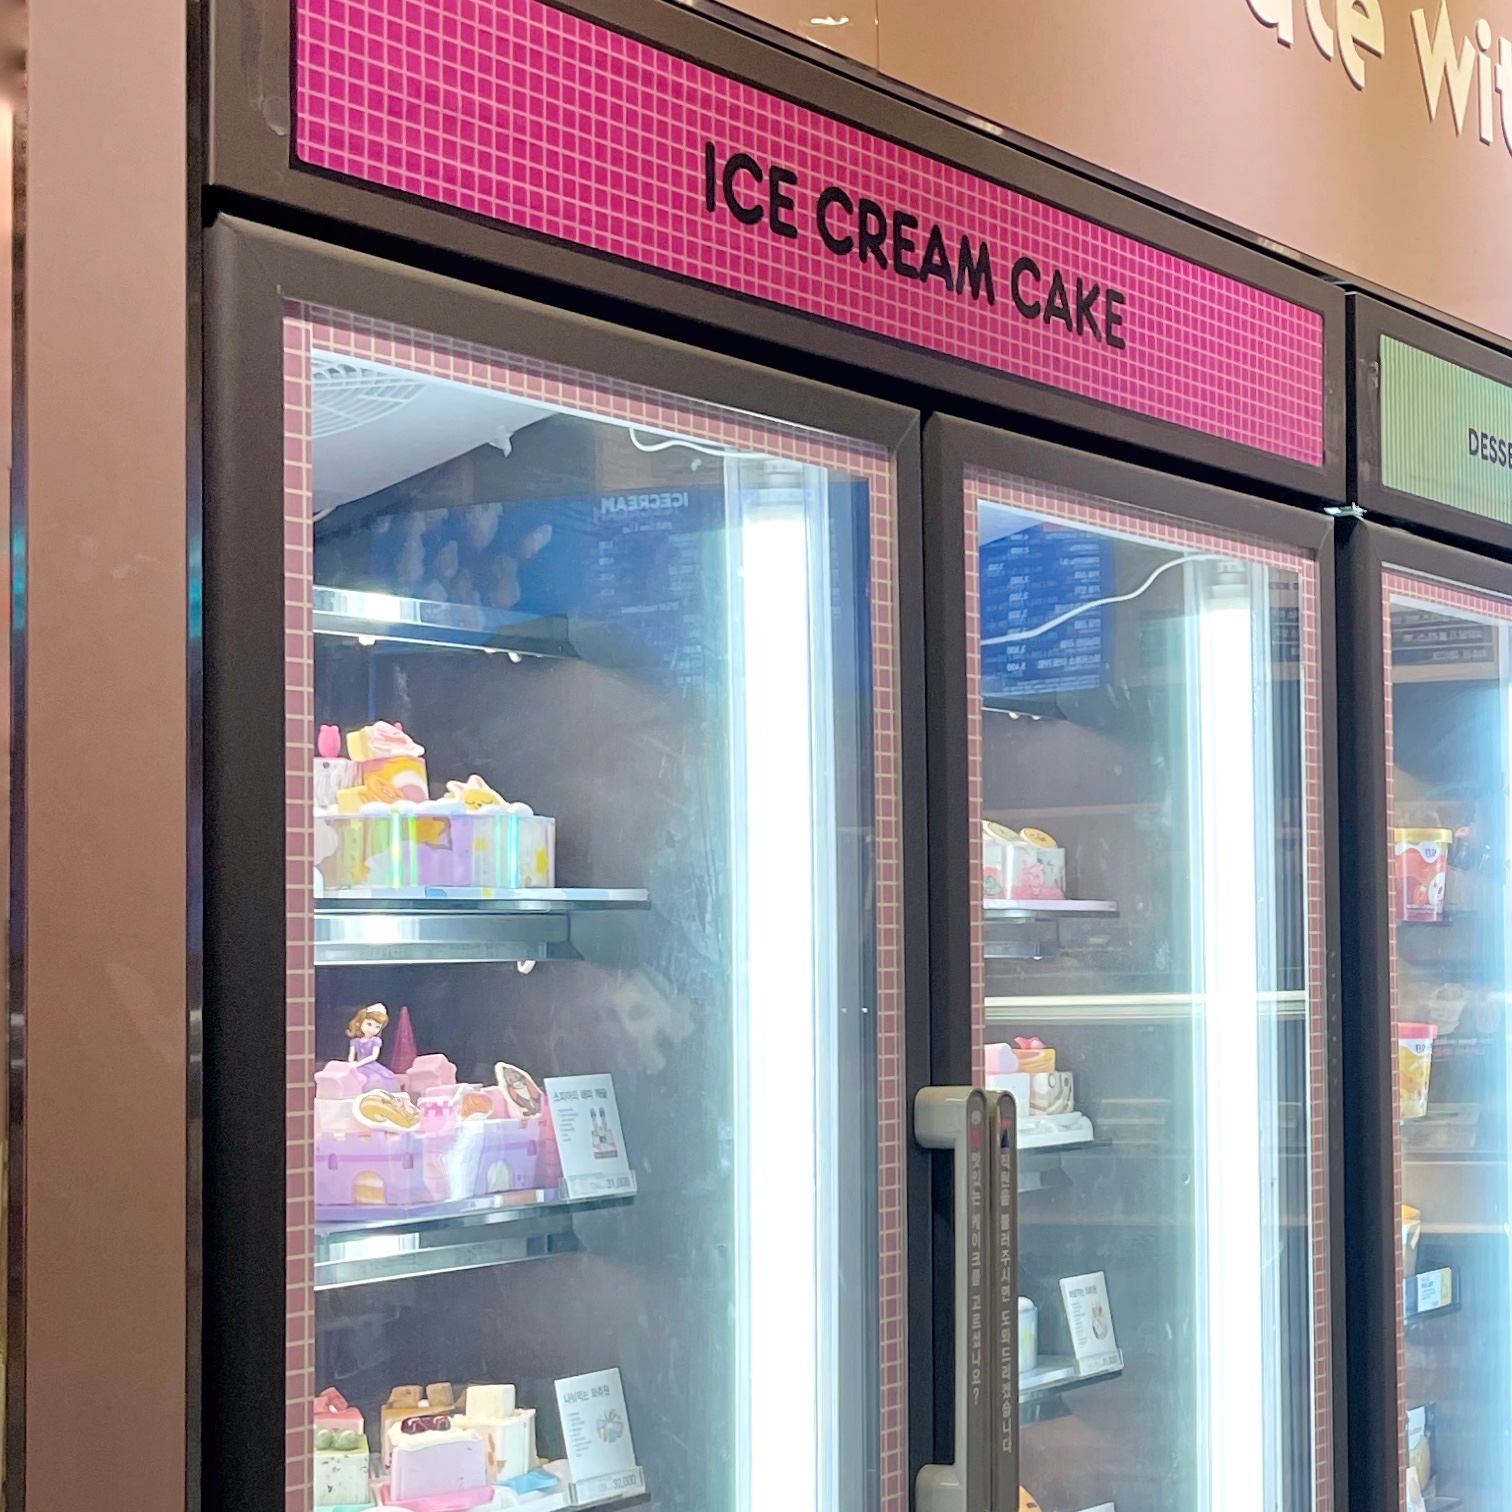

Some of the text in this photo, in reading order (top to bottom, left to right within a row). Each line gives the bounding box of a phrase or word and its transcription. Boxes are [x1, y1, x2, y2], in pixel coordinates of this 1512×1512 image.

[705, 141, 1126, 350] ICE CREAM CAKE
